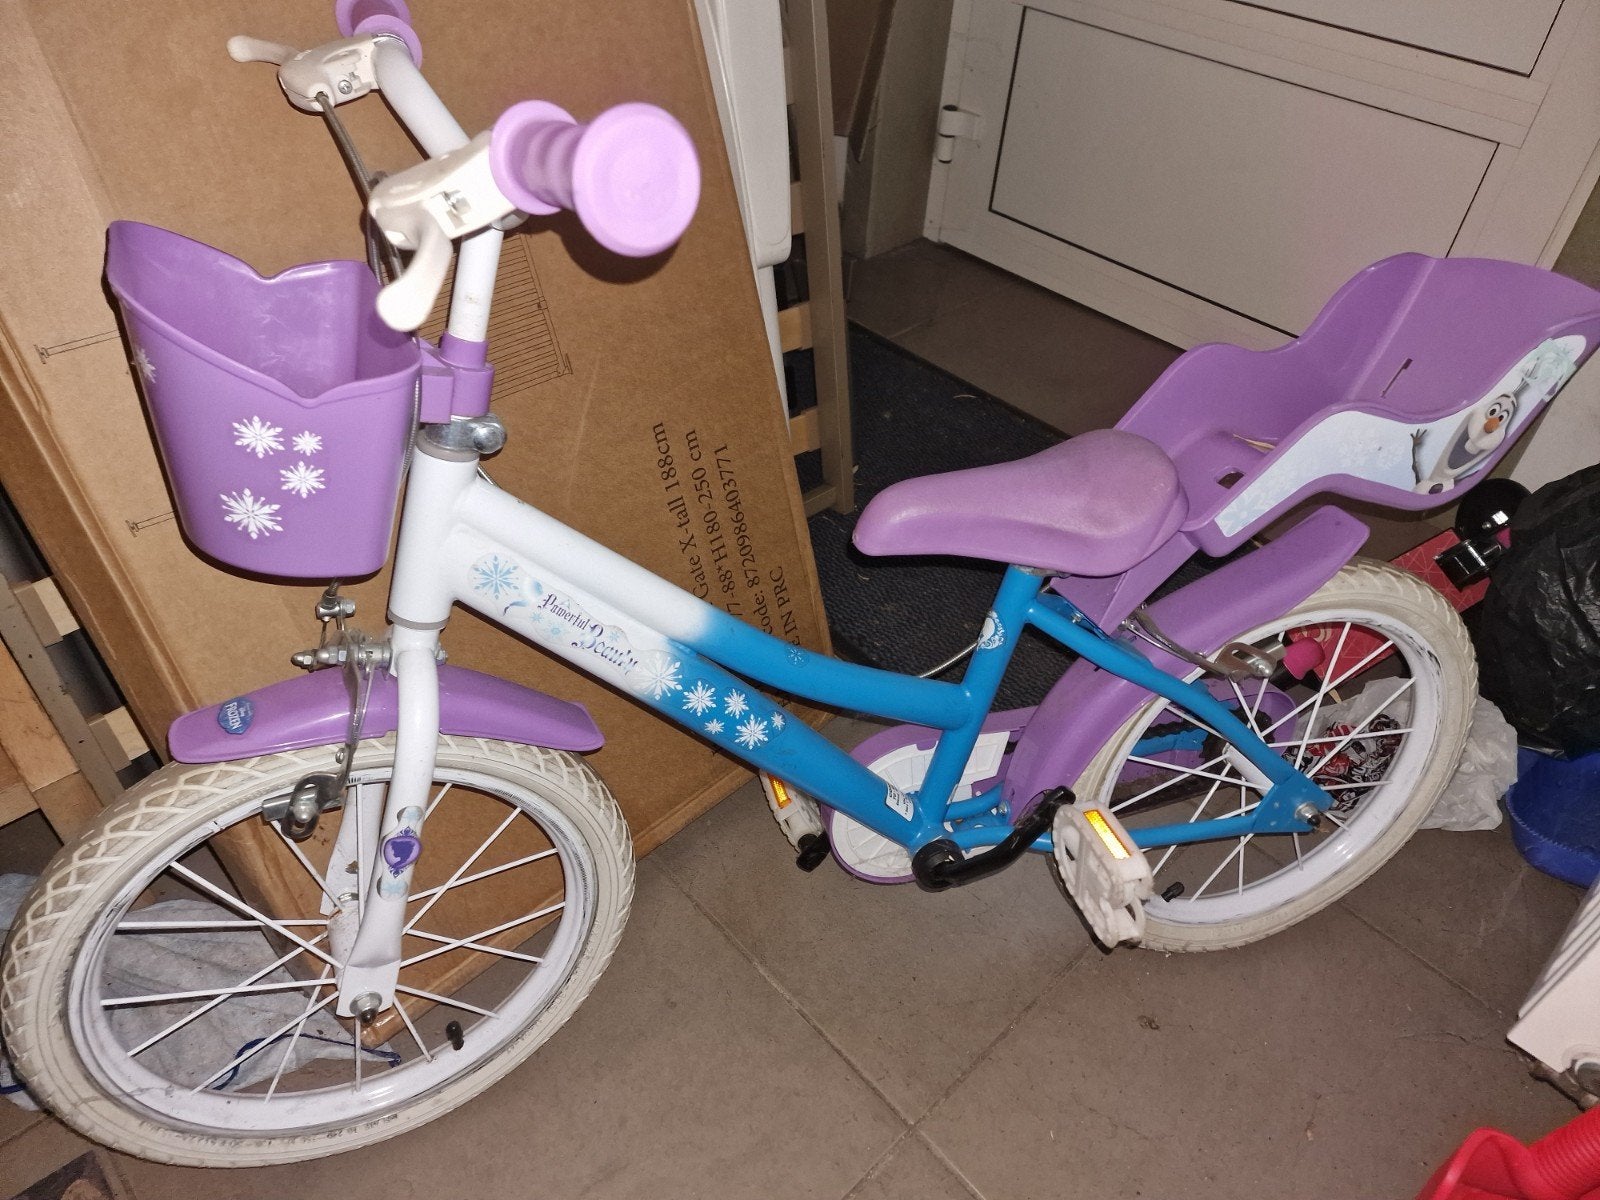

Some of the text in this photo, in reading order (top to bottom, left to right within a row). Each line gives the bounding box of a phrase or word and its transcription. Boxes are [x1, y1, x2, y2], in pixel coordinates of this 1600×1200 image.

[686, 429, 701, 461] cm
[653, 422, 709, 599] Gate X-tall 188cm
[714, 444, 760, 588] 8720986403771
[770, 566, 790, 609] PRC
[537, 594, 639, 675] Powerful Beauty
[781, 610, 798, 635] IN
[225, 702, 242, 729] FROZEN
